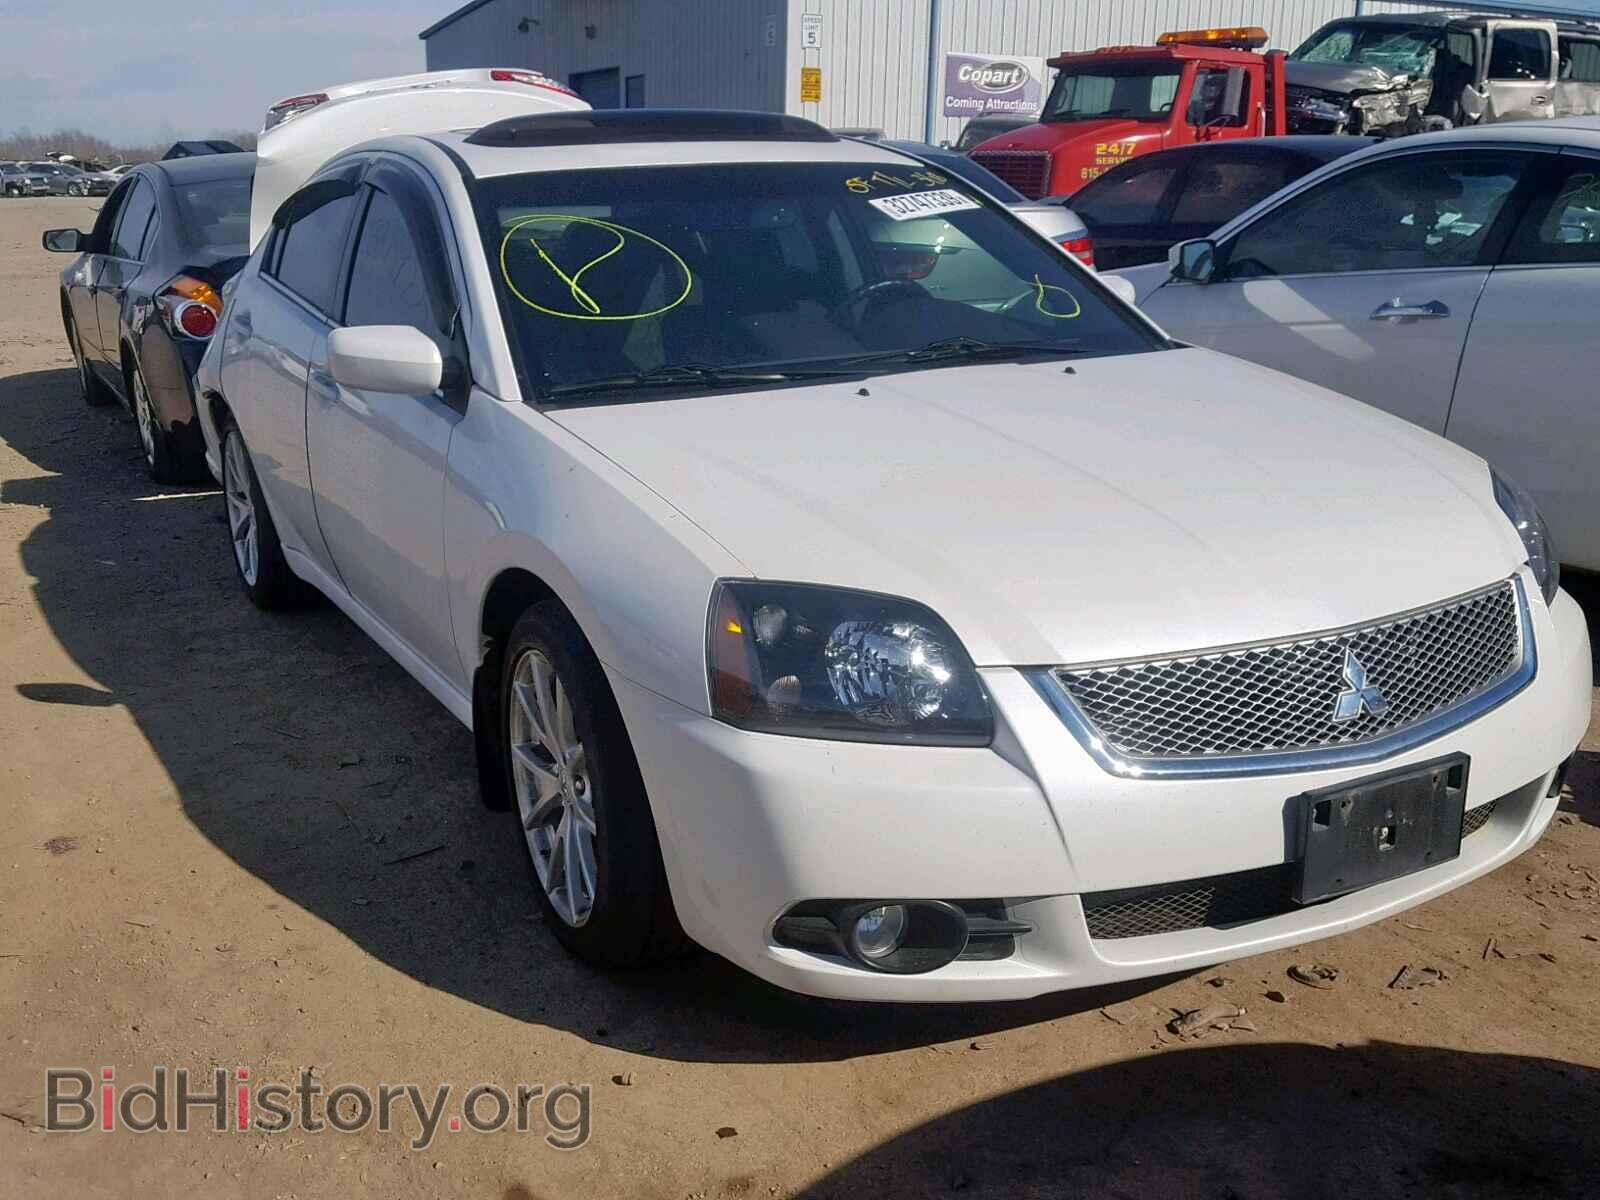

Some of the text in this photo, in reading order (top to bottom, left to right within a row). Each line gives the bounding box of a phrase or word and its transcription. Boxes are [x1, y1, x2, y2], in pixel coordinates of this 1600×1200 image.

[807, 31, 817, 45] 5
[959, 65, 1020, 86] Copart
[946, 96, 1038, 111] Coming Attractions
[1096, 142, 1137, 156] 24/7
